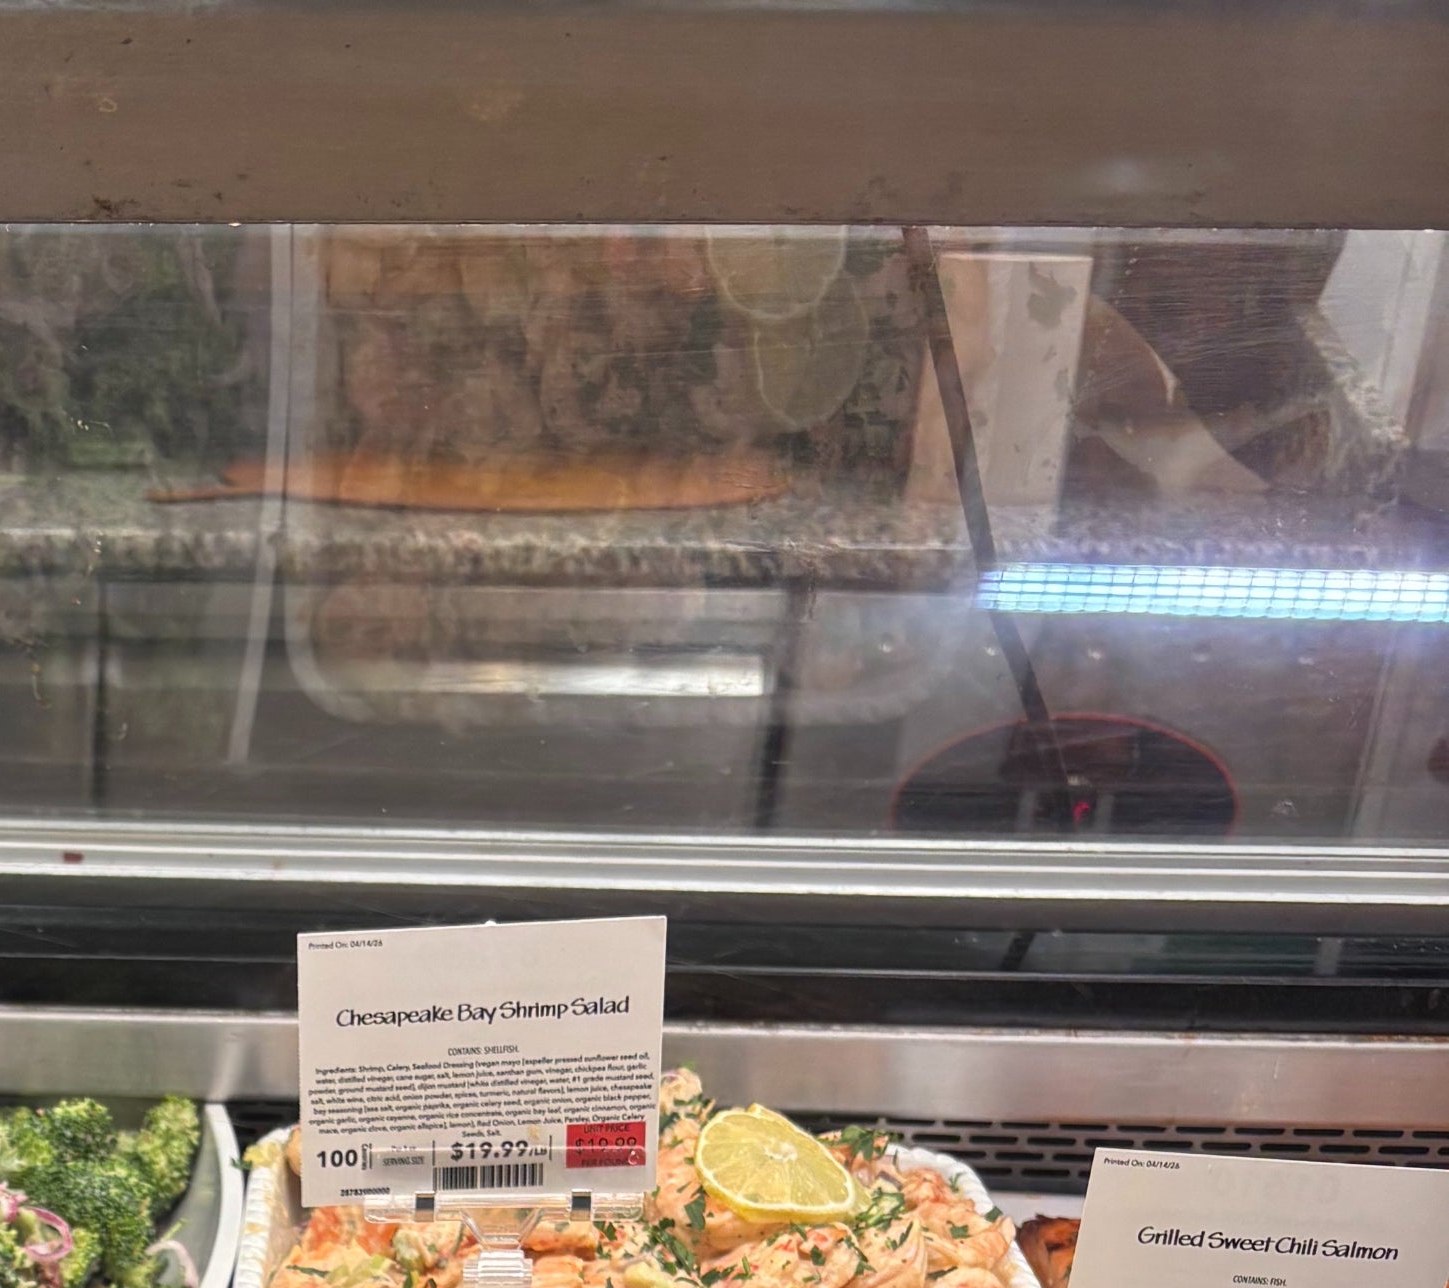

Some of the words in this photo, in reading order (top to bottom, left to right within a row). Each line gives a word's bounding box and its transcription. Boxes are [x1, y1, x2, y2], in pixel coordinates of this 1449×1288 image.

[336, 1005, 453, 1027] Chesapeake
[457, 1004, 497, 1024] Bay
[499, 999, 569, 1020] Shrimp
[571, 996, 629, 1016] Salad
[317, 1150, 357, 1168] 100
[1137, 1226, 1205, 1248] Grilled
[1208, 1232, 1275, 1252] Sweet
[1275, 1236, 1319, 1256] Chili
[1321, 1240, 1399, 1261] Salmon
[1232, 1274, 1268, 1285] CONTAINS:
[1269, 1277, 1286, 1286] FISH.
